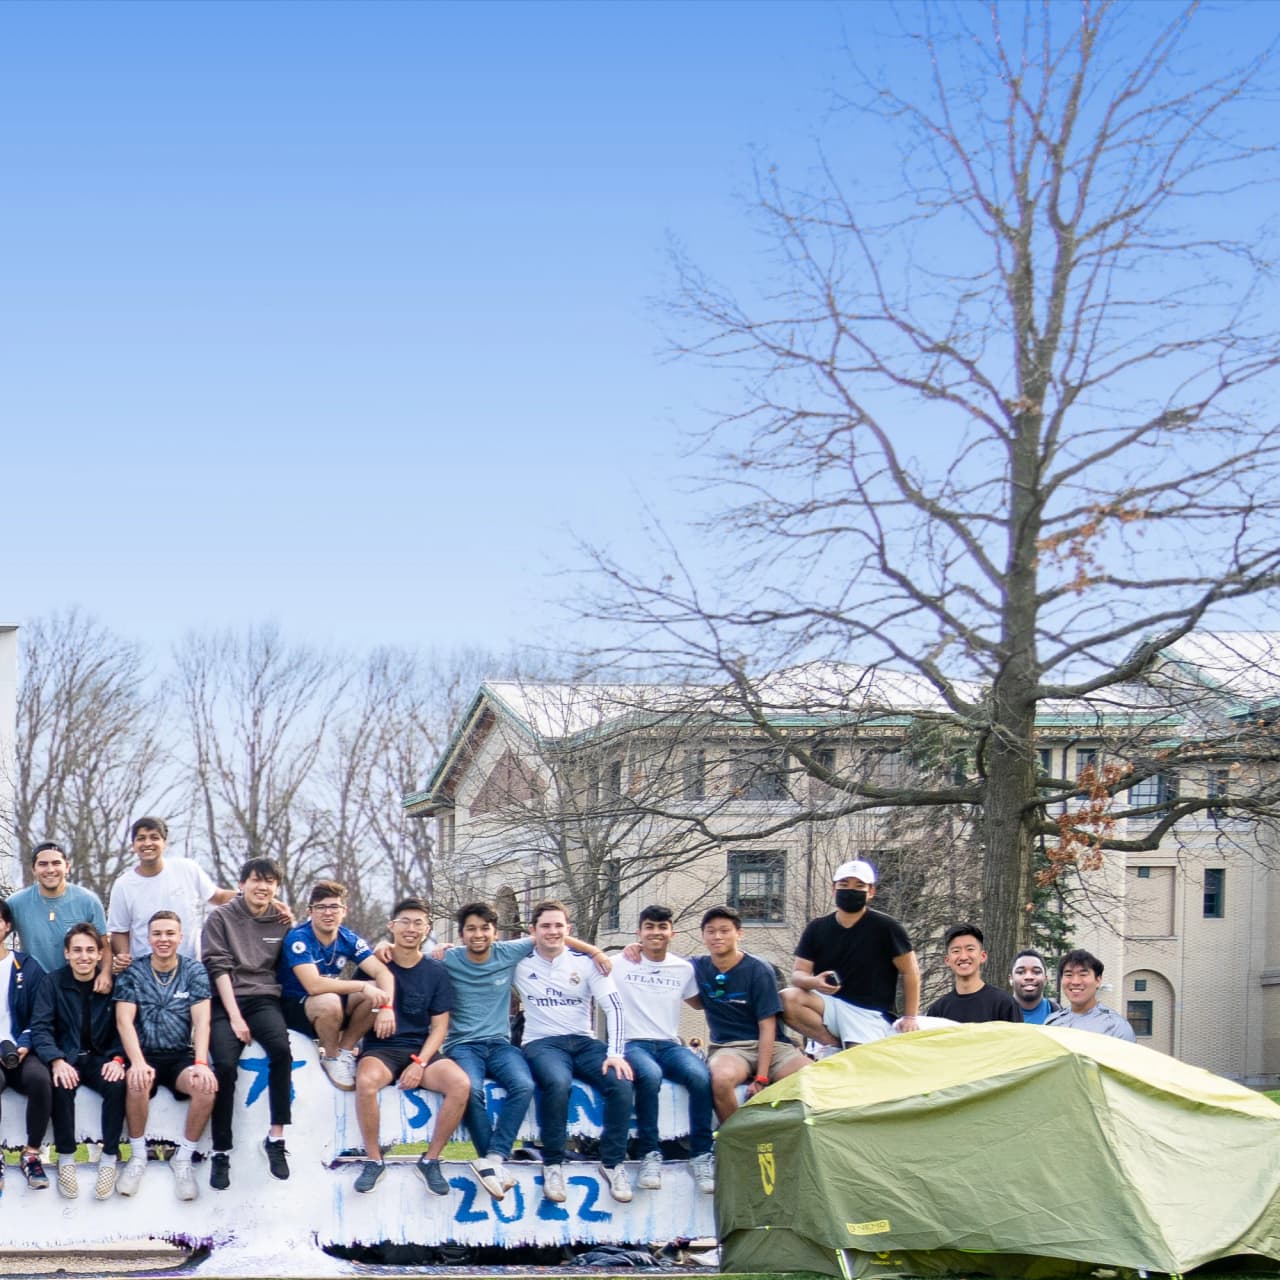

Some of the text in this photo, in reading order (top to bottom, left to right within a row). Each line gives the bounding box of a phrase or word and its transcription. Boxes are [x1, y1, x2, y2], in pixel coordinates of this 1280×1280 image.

[624, 973, 681, 987] ATLANTIS
[545, 987, 562, 998] Fly
[527, 995, 583, 1007] Emirates
[449, 1175, 613, 1223] 2022
